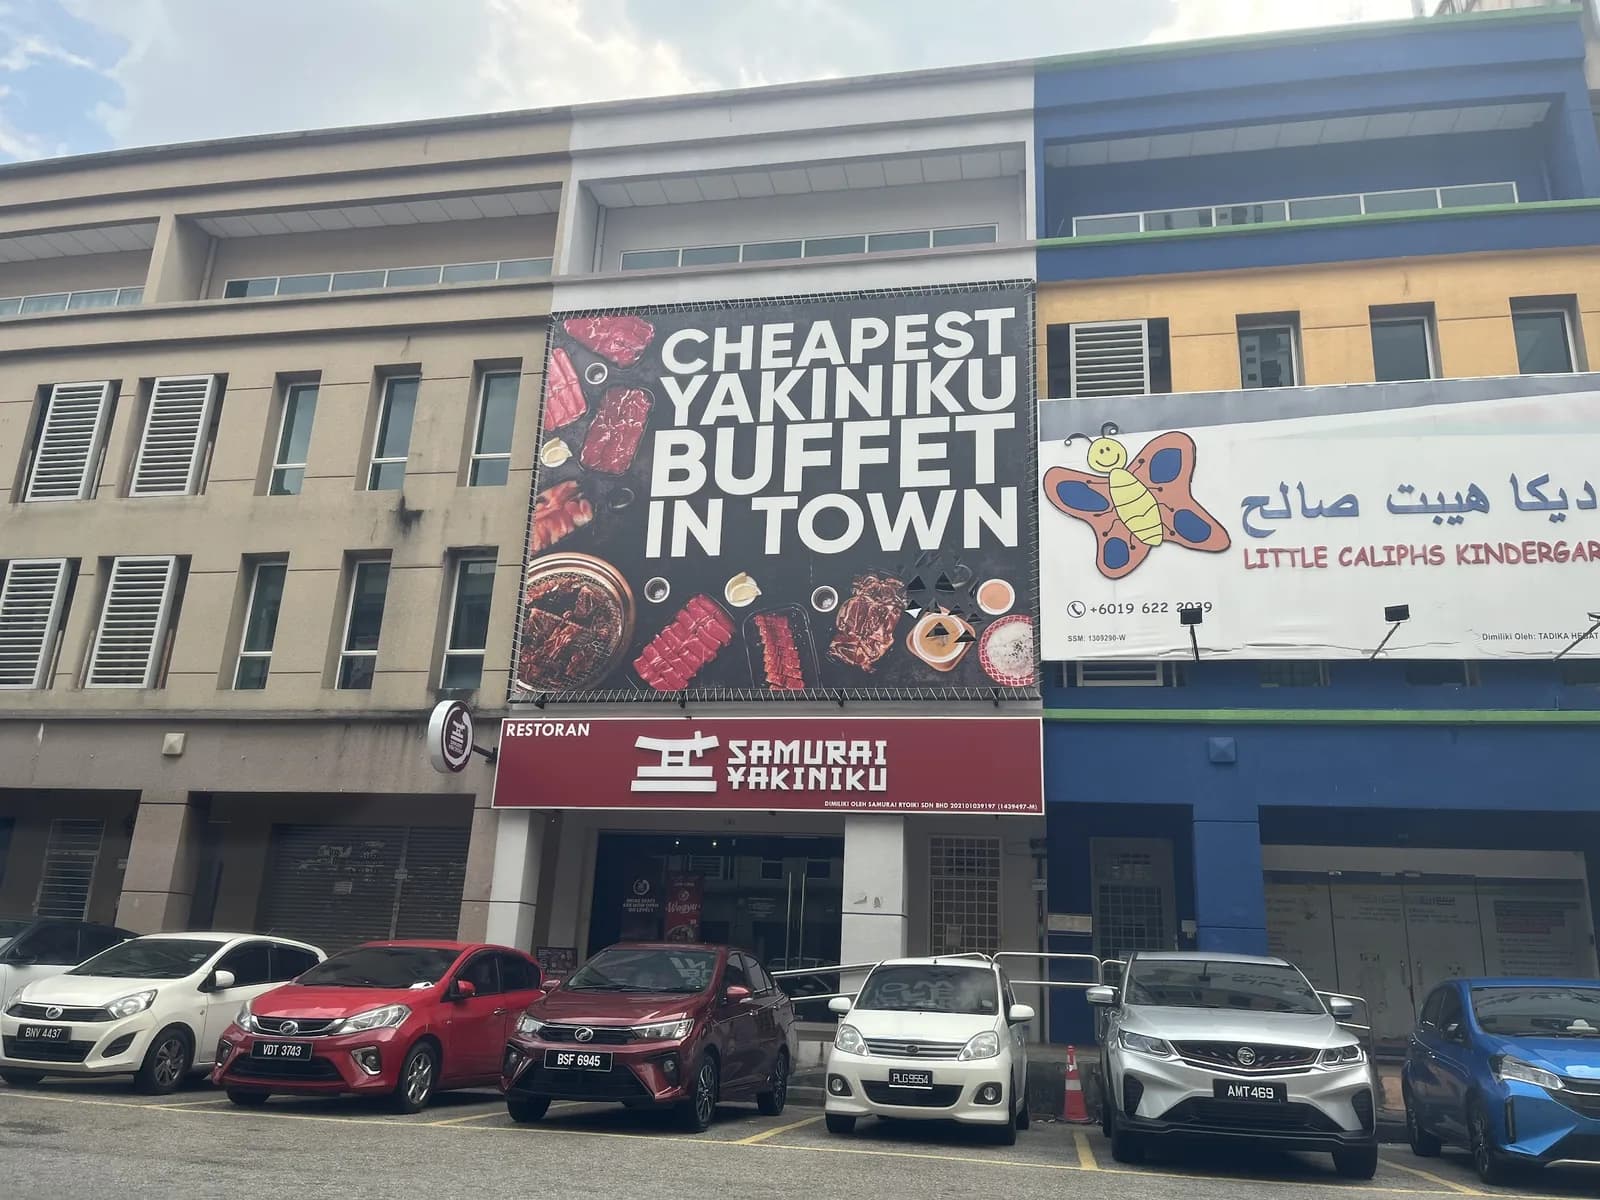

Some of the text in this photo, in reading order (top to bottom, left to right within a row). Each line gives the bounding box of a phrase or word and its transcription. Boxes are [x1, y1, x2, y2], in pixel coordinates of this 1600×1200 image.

[661, 307, 1016, 374] CHEAPEST
[659, 356, 1017, 427] YAKINIKU
[650, 413, 1015, 498] BUFFET
[1241, 480, 1360, 538] صالح
[645, 486, 1018, 559] IN TOWN
[1244, 540, 1600, 569] LITTLE CALIPHS KINDERGAR
[1090, 603, 1135, 615] +6019
[1141, 602, 1169, 614] 622
[1482, 633, 1513, 641] Dimiliki
[1514, 633, 1537, 641] Oleh:
[1538, 632, 1570, 640] TADIKA
[505, 723, 591, 738] RESTORAN
[727, 739, 888, 766] SAMURAI
[727, 766, 888, 792] YAKINIKU
[25, 1027, 62, 1039] BNV 4437
[263, 1044, 302, 1057] VDT 3743
[557, 1053, 600, 1067] BSF 6945
[1227, 1084, 1274, 1099] AMT469
